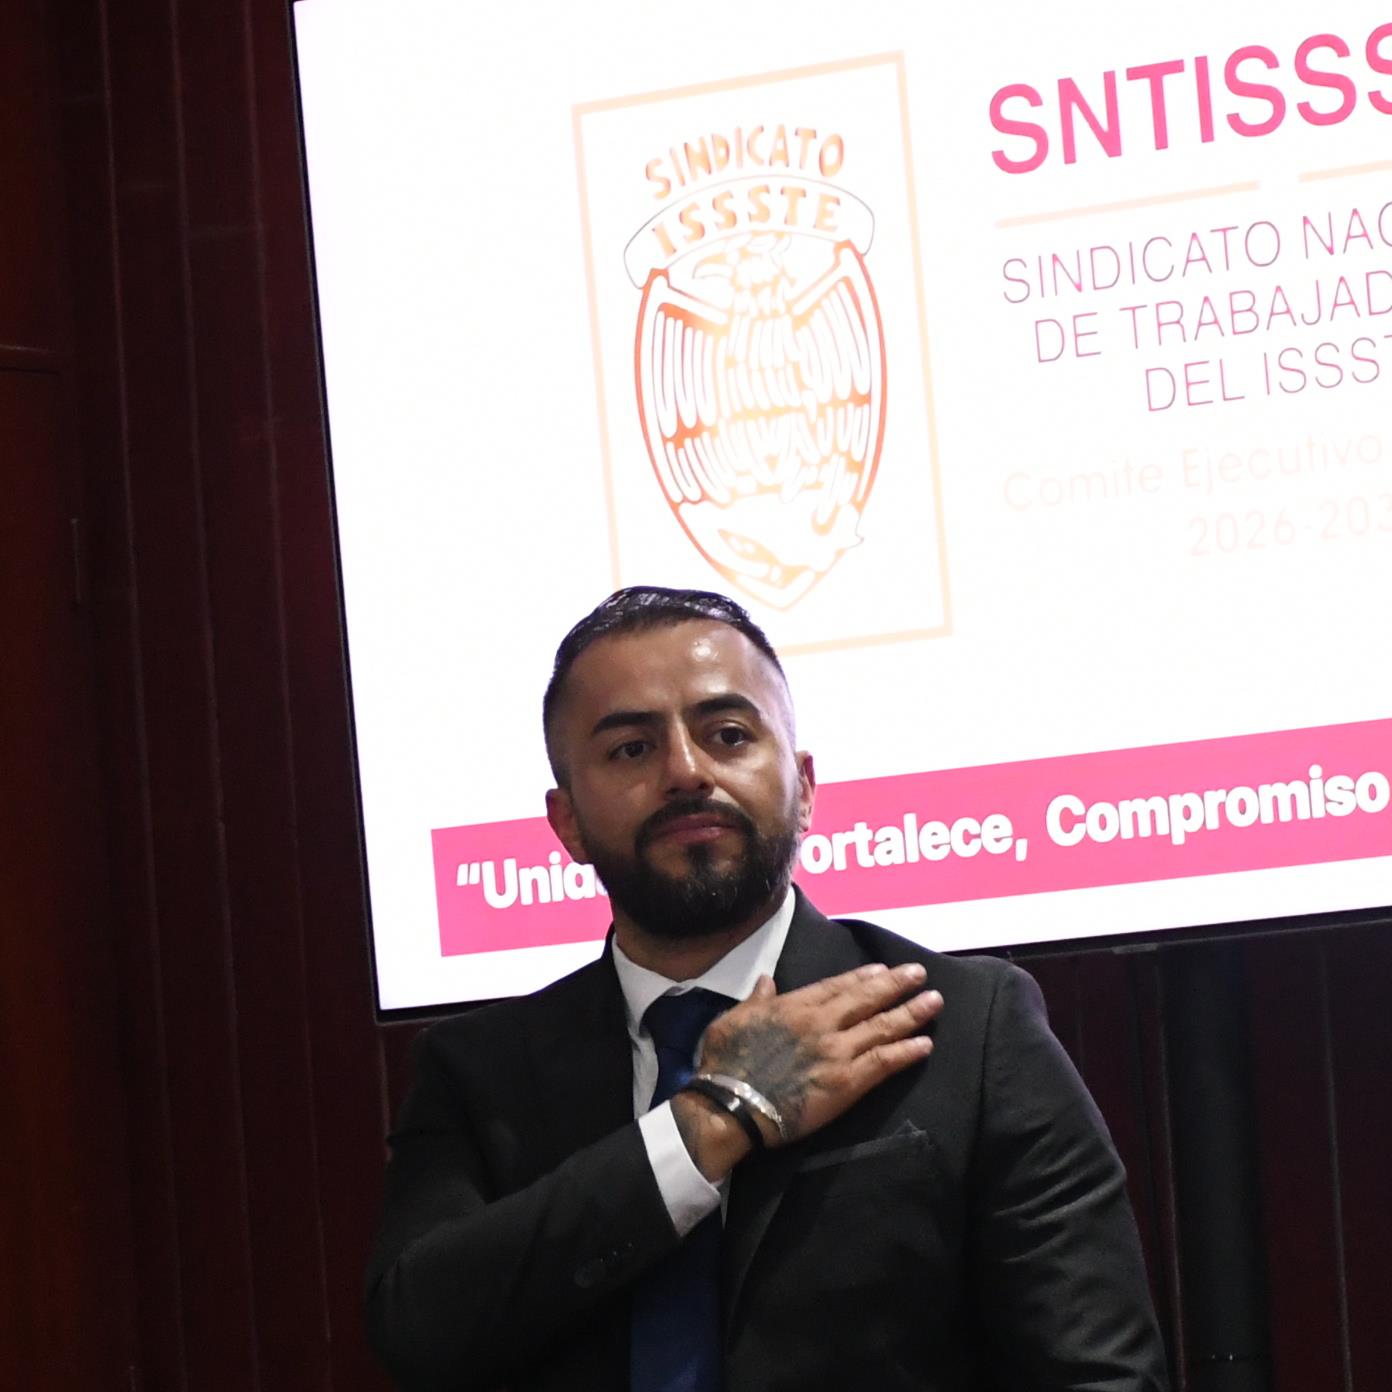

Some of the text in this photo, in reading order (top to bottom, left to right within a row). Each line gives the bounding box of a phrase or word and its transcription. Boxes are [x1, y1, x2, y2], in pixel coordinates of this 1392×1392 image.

[645, 124, 845, 199] SINDICATO
[652, 184, 841, 259] ISSSTE
[1003, 221, 1280, 303] SINDICATO
[1035, 312, 1101, 363] DE
[1146, 359, 1245, 412] DEL
[800, 812, 1028, 874] ortalece,
[1046, 764, 1390, 847] Compromiso
